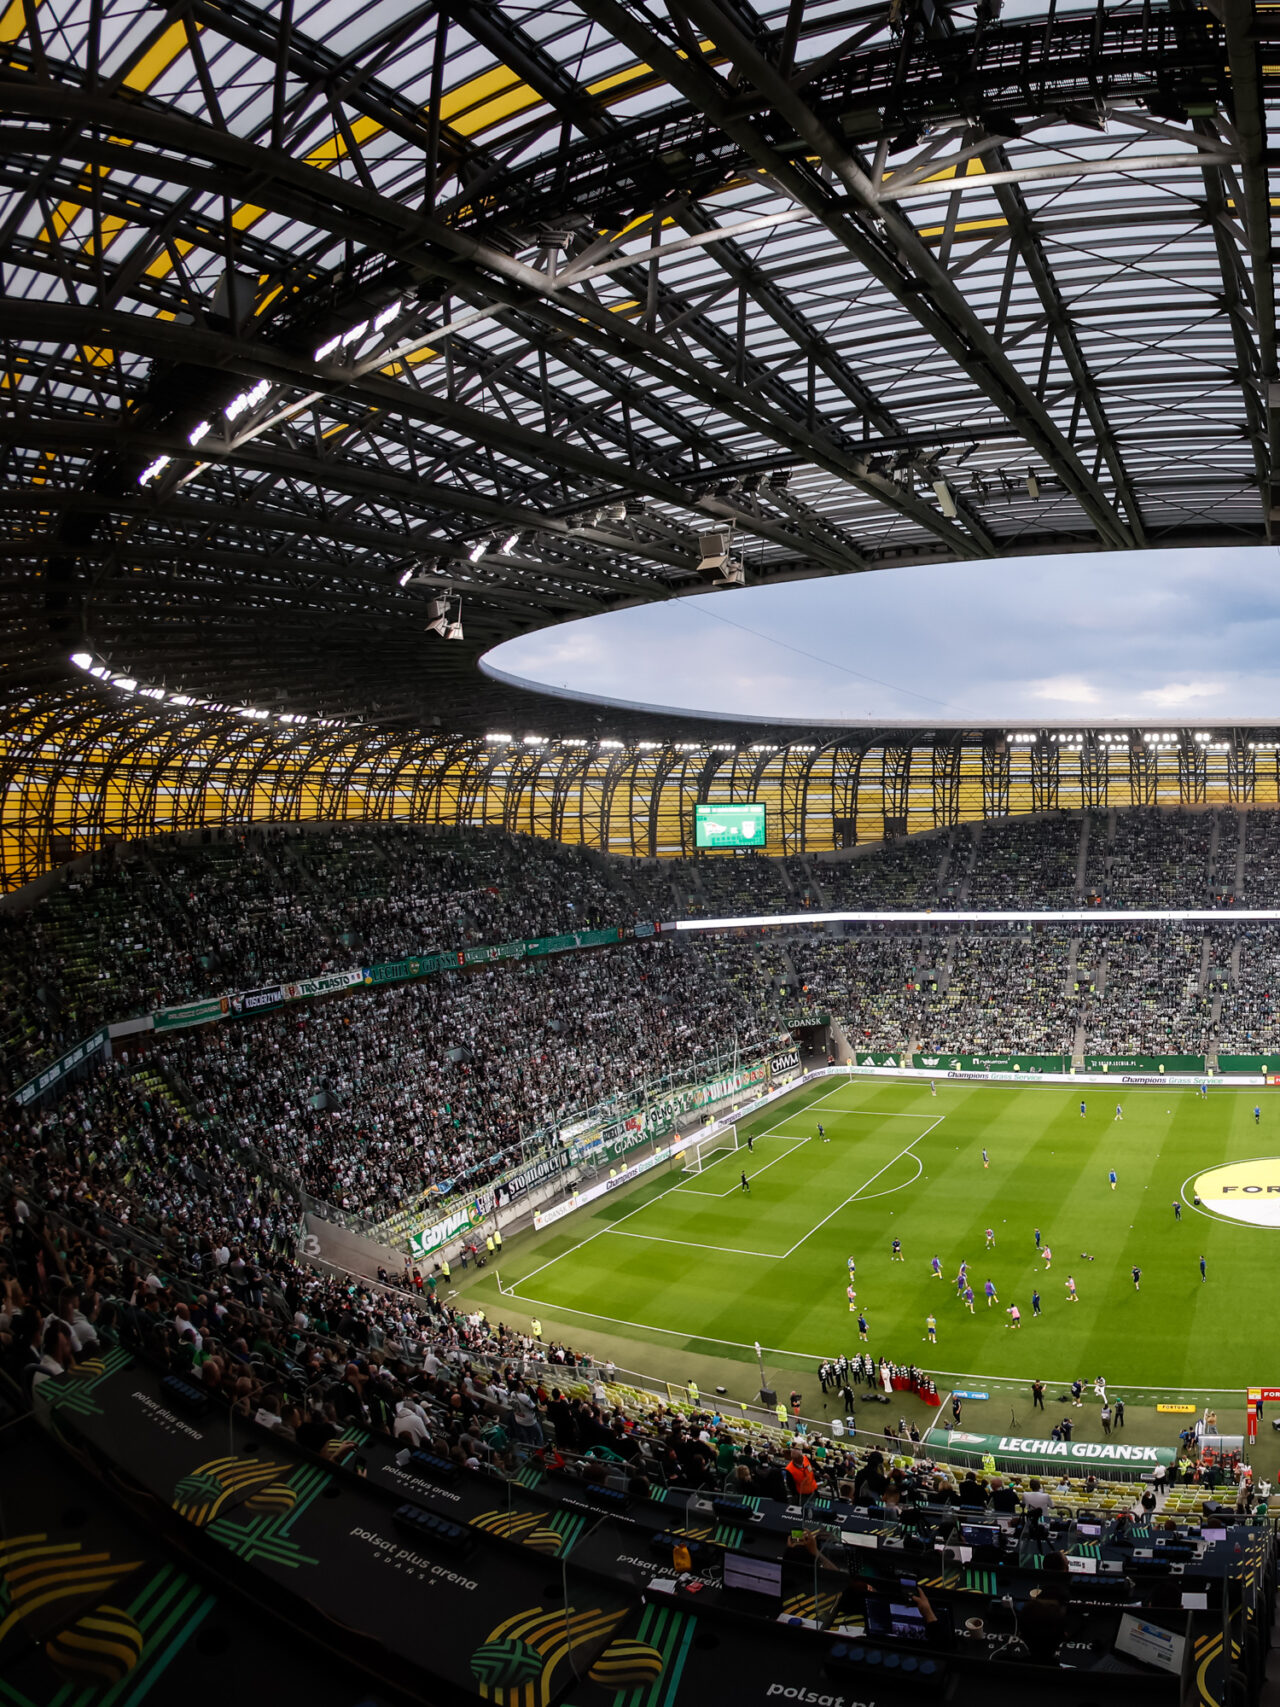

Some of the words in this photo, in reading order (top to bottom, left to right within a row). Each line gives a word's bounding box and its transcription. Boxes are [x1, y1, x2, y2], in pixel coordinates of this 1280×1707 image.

[372, 964, 409, 981] LECHIA
[827, 1066, 848, 1075] Grass
[850, 1066, 875, 1074] Service
[947, 1071, 989, 1081] Champions
[1014, 1073, 1043, 1081] Service
[1122, 1076, 1167, 1085] Champions
[1169, 1076, 1193, 1084] Grass
[1194, 1076, 1223, 1084] Service
[717, 1112, 742, 1128] Champions
[606, 1168, 638, 1190] Champions
[421, 1208, 469, 1250] GDYNIA
[304, 1234, 321, 1255] 3
[131, 1391, 160, 1412] polsat
[156, 1408, 178, 1423] plus
[176, 1419, 203, 1440] arena
[999, 1437, 1069, 1457] LECHIA
[1071, 1441, 1159, 1461] GDAŃSK
[382, 1463, 413, 1485] polsat
[409, 1475, 433, 1491] plus
[432, 1485, 461, 1502] arena
[350, 1524, 398, 1552] polsat
[395, 1547, 430, 1570] plus
[430, 1560, 479, 1591] arena
[616, 1554, 658, 1571] polsat
[689, 1573, 723, 1590] aren
[766, 1681, 848, 1707] polsat
